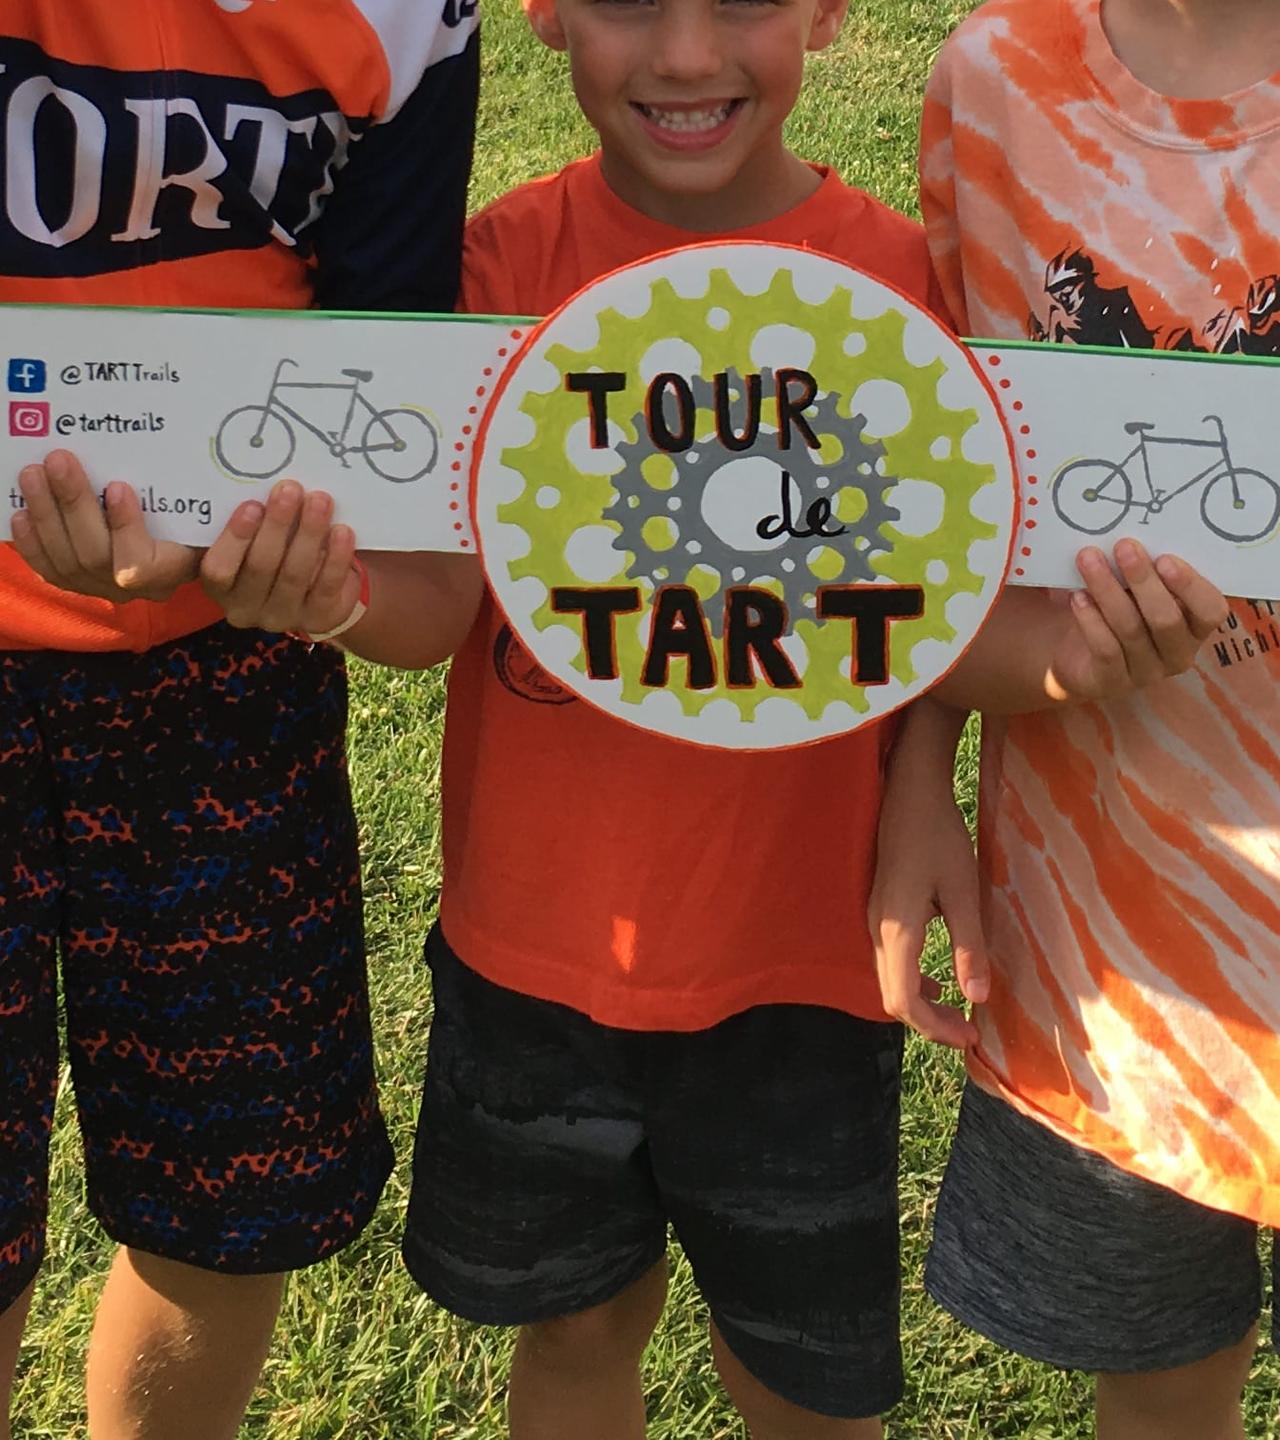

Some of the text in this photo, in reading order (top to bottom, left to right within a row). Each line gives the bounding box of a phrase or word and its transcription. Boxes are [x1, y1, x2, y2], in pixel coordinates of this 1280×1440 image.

[56, 412, 166, 436] @tarttrails
[565, 368, 822, 453] TOUR
[756, 471, 850, 540] de
[551, 585, 925, 690] TART
